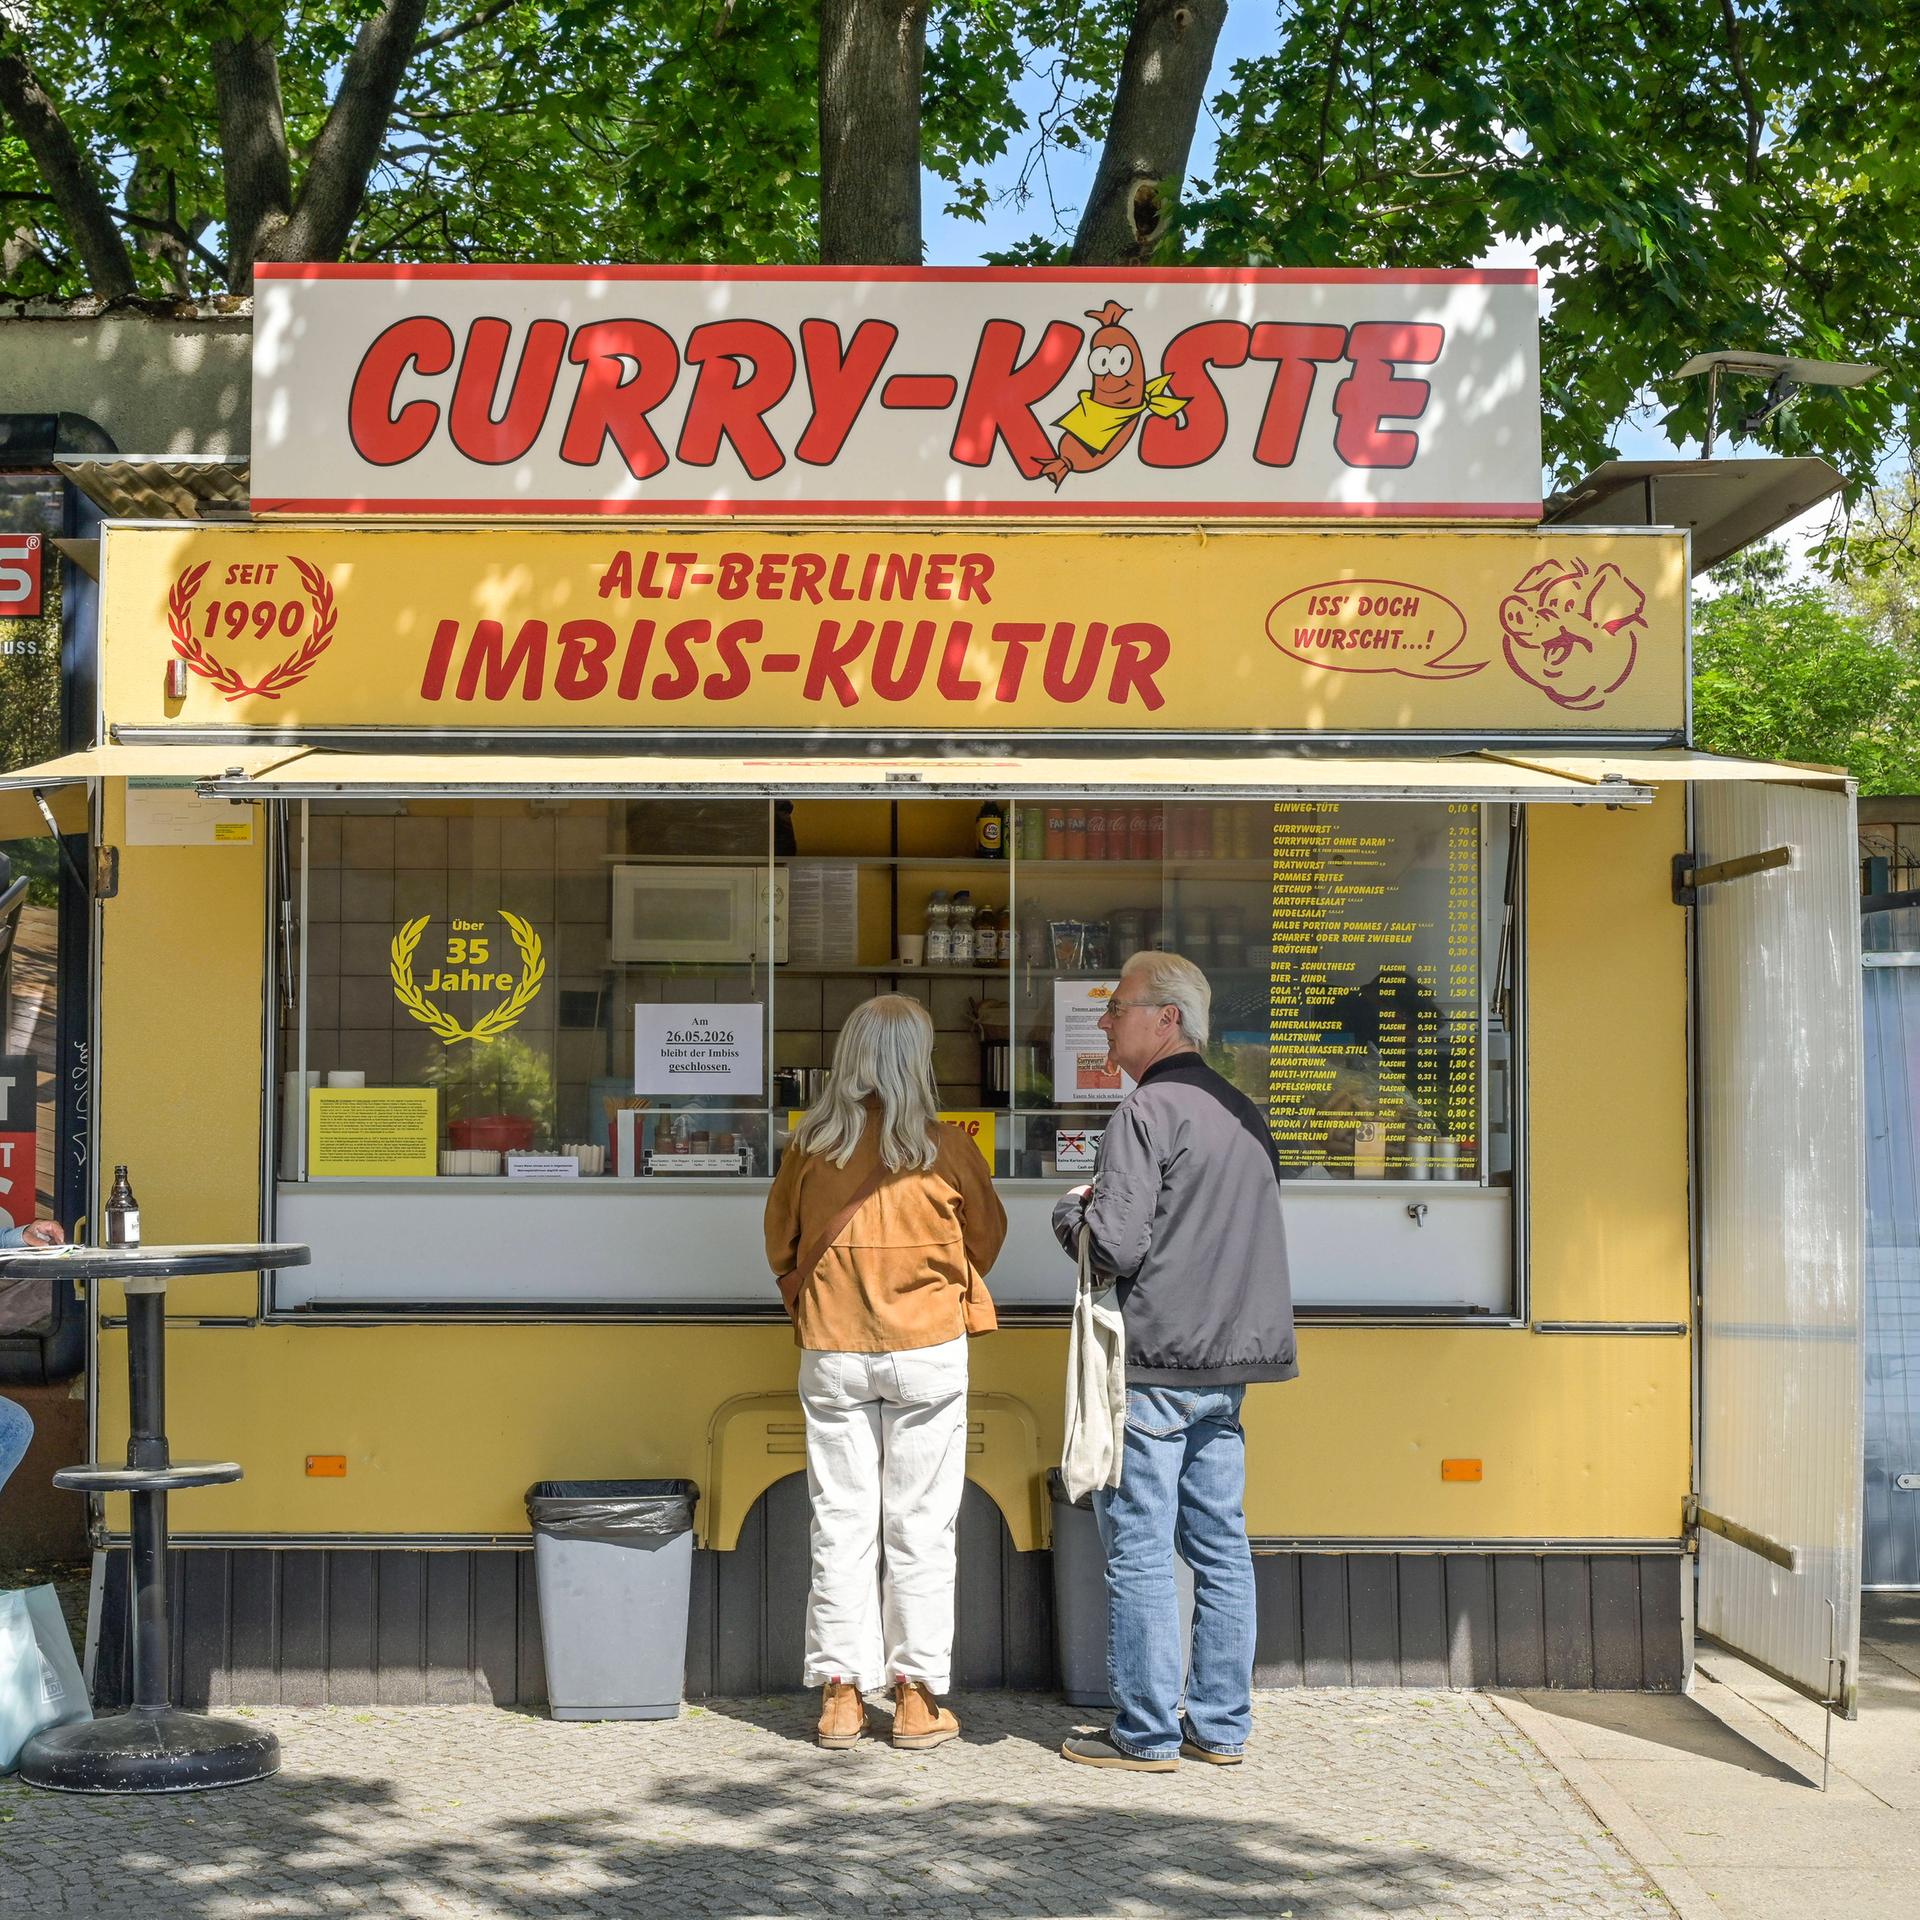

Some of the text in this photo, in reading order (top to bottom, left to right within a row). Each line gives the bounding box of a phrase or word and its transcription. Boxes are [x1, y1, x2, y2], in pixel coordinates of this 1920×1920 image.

[225, 563, 279, 585] SEIT
[598, 550, 995, 605] ALT-BERLINER
[1357, 595, 1420, 618] DOCH
[203, 600, 305, 641] 1990
[1293, 629, 1434, 651] WURSCHT...!
[420, 618, 1171, 712] IMBISS-KULTUR
[1274, 802, 1340, 812] EINWEG-TÜTE
[1273, 824, 1332, 834] CURRYWURST
[1273, 836, 1332, 846] CURRYWURST
[1333, 837, 1358, 846] OHNE
[1360, 838, 1386, 846] DARM
[1273, 848, 1311, 857] BULETTE
[1273, 860, 1326, 870] BRATWURST
[1273, 872, 1312, 881] POMMES
[1314, 873, 1344, 882] FRITES
[1272, 885, 1312, 894] KETCHUP
[1334, 886, 1385, 894] MAYONAISE
[1272, 896, 1346, 906] KARTOFFELSALAT
[1272, 908, 1327, 918] NUDELSALAT
[452, 918, 484, 932] Über
[1272, 920, 1300, 930] HALBE
[1302, 922, 1341, 930] PORTION
[1344, 922, 1382, 930] POMMES
[1390, 922, 1417, 931] SALAT
[1316, 934, 1340, 942] ODER
[1342, 934, 1366, 942] ROHE
[1368, 934, 1412, 943] ZWIEBELN
[445, 937, 489, 965] 35
[1272, 944, 1318, 954] BRÖTCHEN
[1270, 962, 1291, 970] BIER
[1300, 962, 1356, 970] SCHULTHEISS
[424, 969, 514, 993] Jahre
[1270, 974, 1291, 982] BIER
[1300, 974, 1327, 983] KINDL
[1305, 987, 1326, 995] COLA
[1306, 996, 1336, 1005] EXOTIC
[1270, 1008, 1300, 1016] EISTEE
[692, 1018, 708, 1026] Am
[1270, 1020, 1342, 1030] MINERALWASSER
[666, 1030, 734, 1043] 26.05.2026
[1270, 1033, 1322, 1041] MALZTRUNK
[660, 1049, 739, 1058] bleibt der Imbiss
[1270, 1046, 1343, 1054] MINERALWASSER
[1345, 1046, 1368, 1054] STILL
[669, 1061, 731, 1073] geschlossen.
[1270, 1058, 1327, 1066] KAKAOTRUNK
[1270, 1070, 1336, 1078] MULTI-VITAMIN
[1270, 1082, 1332, 1091] APFELSCHORLE
[1270, 1108, 1316, 1116] CAPRI-SUN
[1270, 1120, 1300, 1128] WODKA
[1310, 1120, 1362, 1129] WEINBRAND
